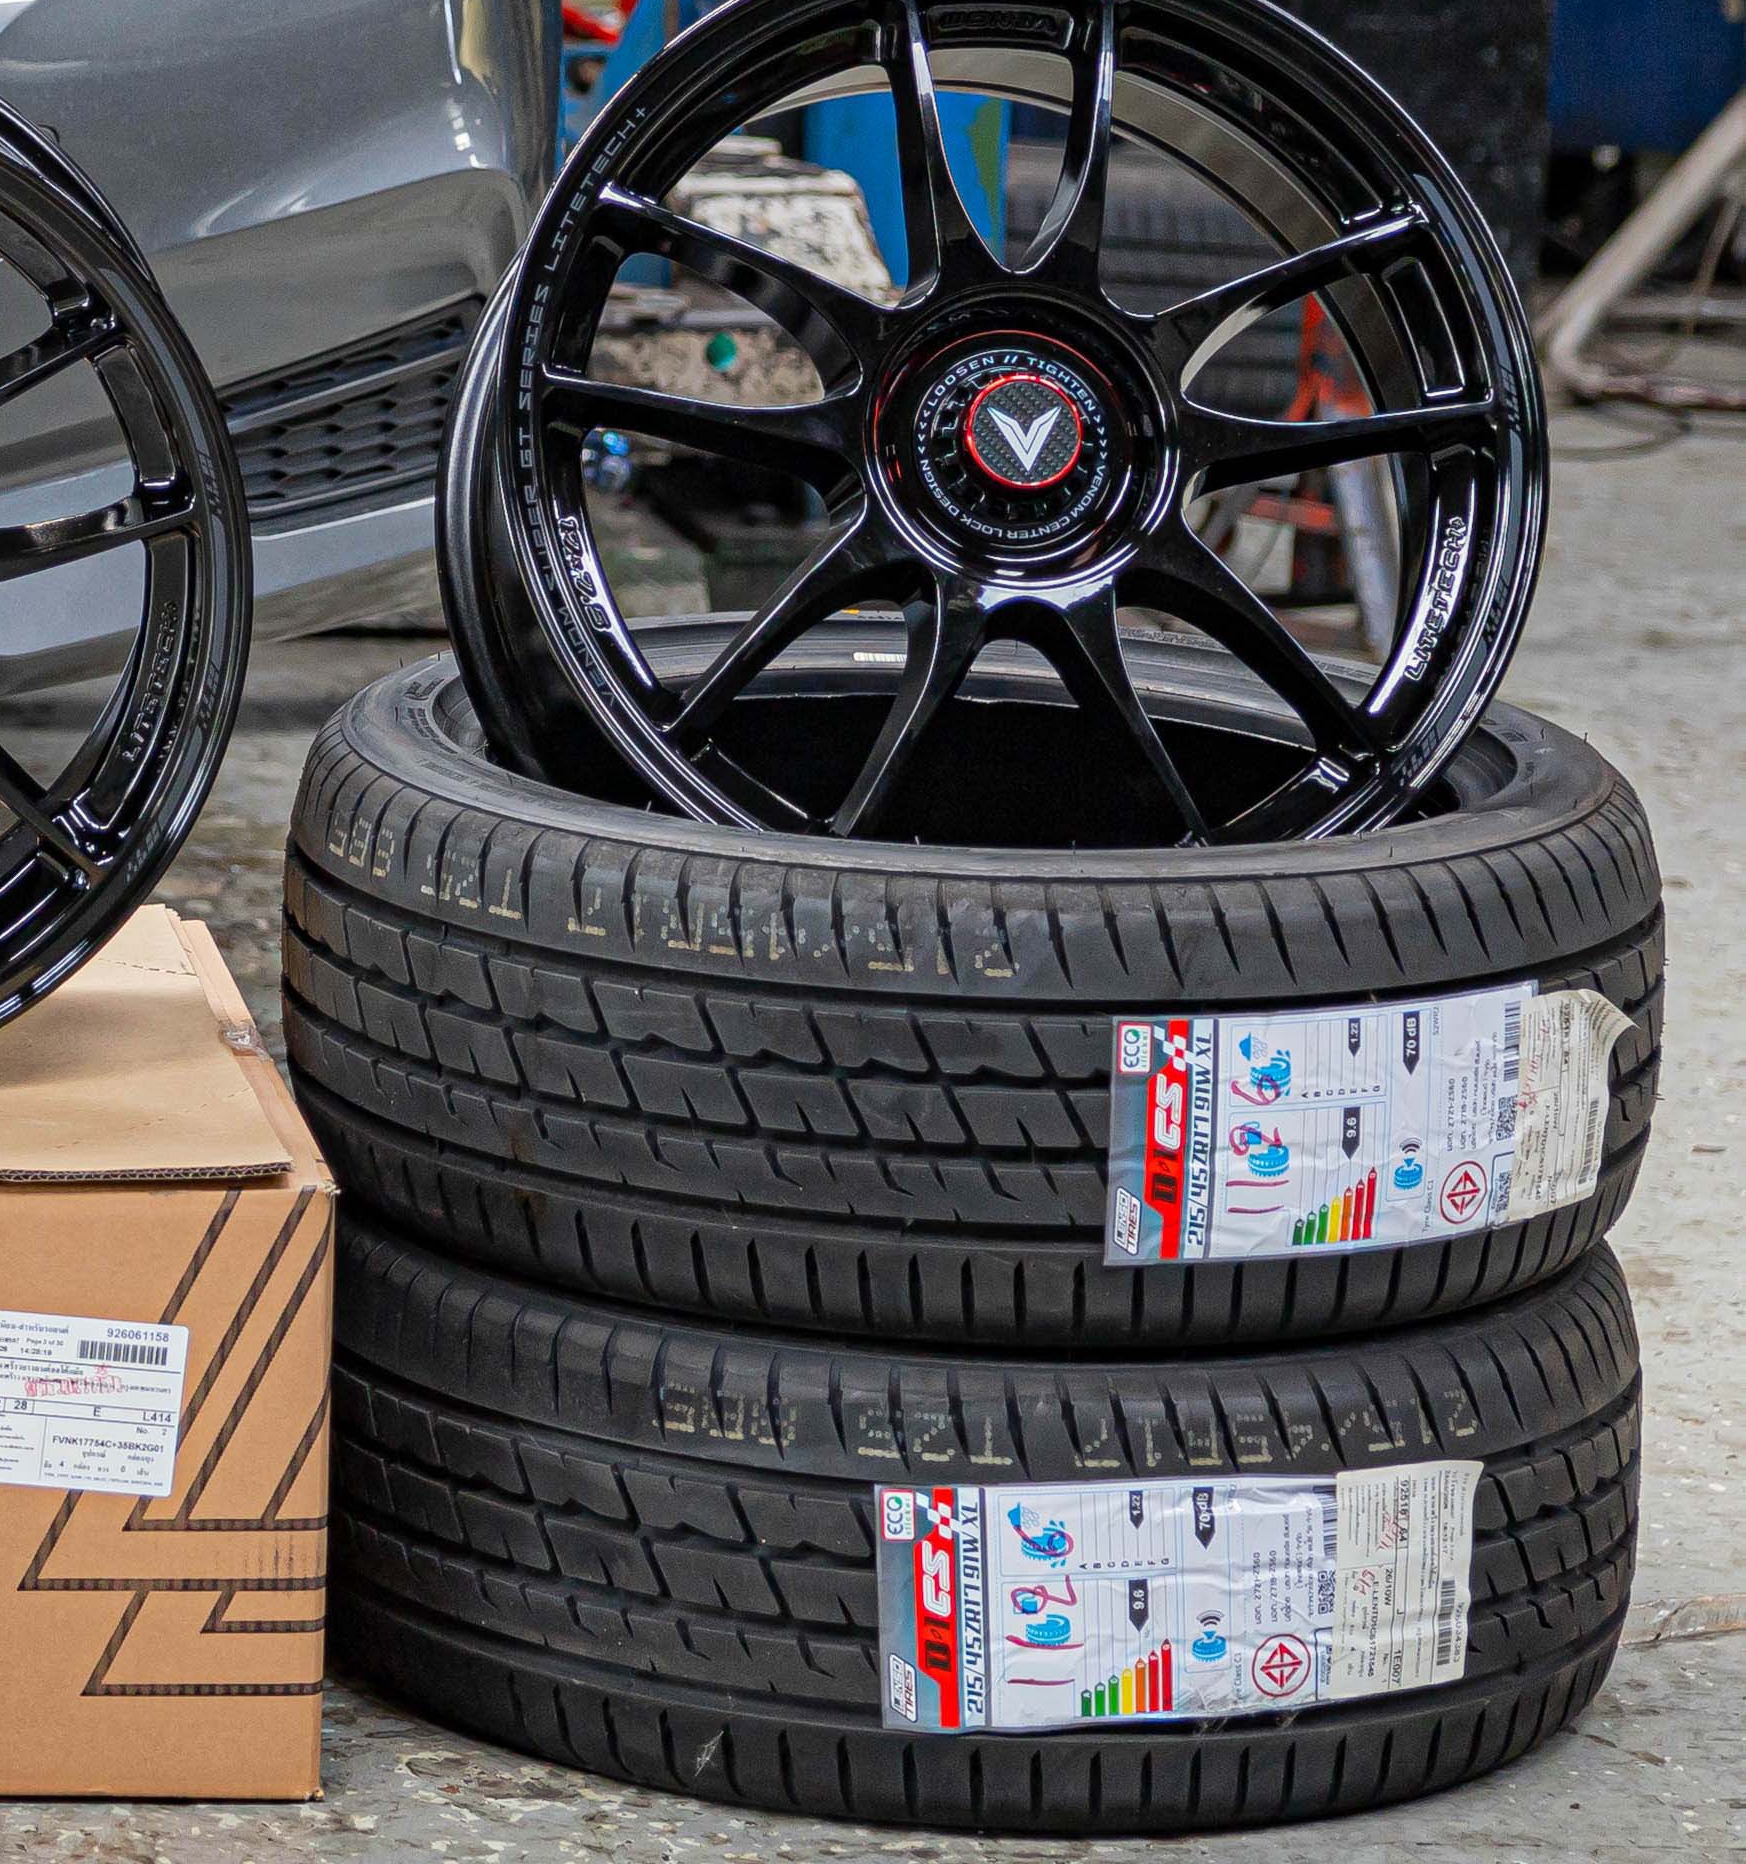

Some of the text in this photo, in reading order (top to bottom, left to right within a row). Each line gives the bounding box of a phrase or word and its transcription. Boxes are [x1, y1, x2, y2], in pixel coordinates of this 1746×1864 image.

[520, 284, 549, 410] SERIES
[920, 355, 1107, 539] LOOSEN TIGHTEN VENOM CENTER LOCK DESIGN
[1123, 1029, 1139, 1068] ECO
[1406, 1017, 1418, 1058] 70 dB
[1187, 1033, 1213, 1246] 215/45ZR17 91W XL
[1346, 1117, 1357, 1138] 9.6
[107, 1327, 170, 1342] 926061158
[13, 1400, 28, 1410] 28
[93, 1407, 102, 1417] E
[142, 1411, 172, 1423] L414
[52, 1435, 165, 1453] FVNK17754C+35BK2G01
[886, 1496, 903, 1535] ECO
[1132, 1495, 1142, 1516] 1.22
[1197, 1493, 1210, 1511] dB
[961, 1502, 985, 1714] 215/45ZR17 91W XL
[1133, 1589, 1145, 1611] 9.6
